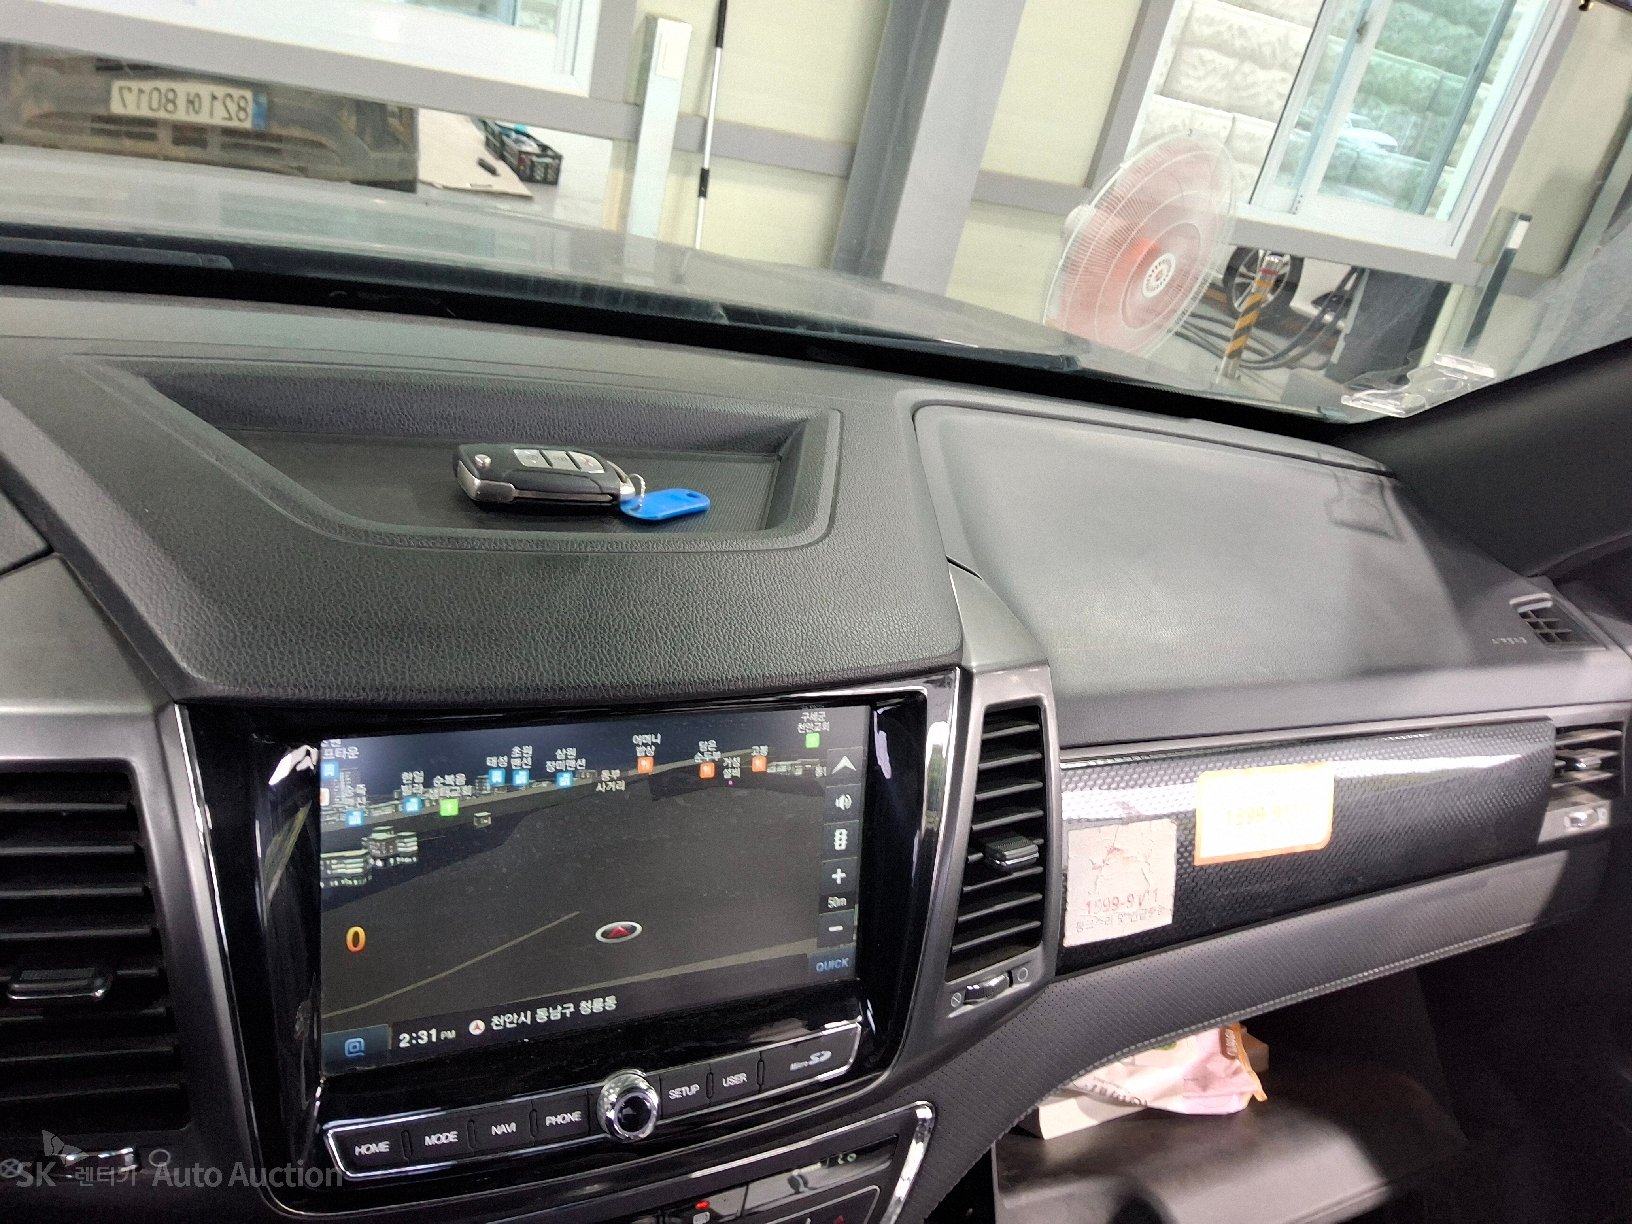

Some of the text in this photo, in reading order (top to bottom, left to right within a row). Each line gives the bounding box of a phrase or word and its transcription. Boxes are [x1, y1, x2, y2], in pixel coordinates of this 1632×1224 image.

[346, 926, 366, 953] 0
[815, 957, 849, 973] QUICK
[490, 1010, 532, 1030] 천안시
[535, 1002, 575, 1023] 동남구
[399, 1028, 438, 1048] 2:31
[722, 1072, 748, 1087] USER
[668, 1083, 700, 1100] SETUP
[545, 1110, 582, 1127] PHONE
[491, 1121, 517, 1136] NAVI
[424, 1130, 458, 1146] MODE
[355, 1140, 390, 1157] HOME
